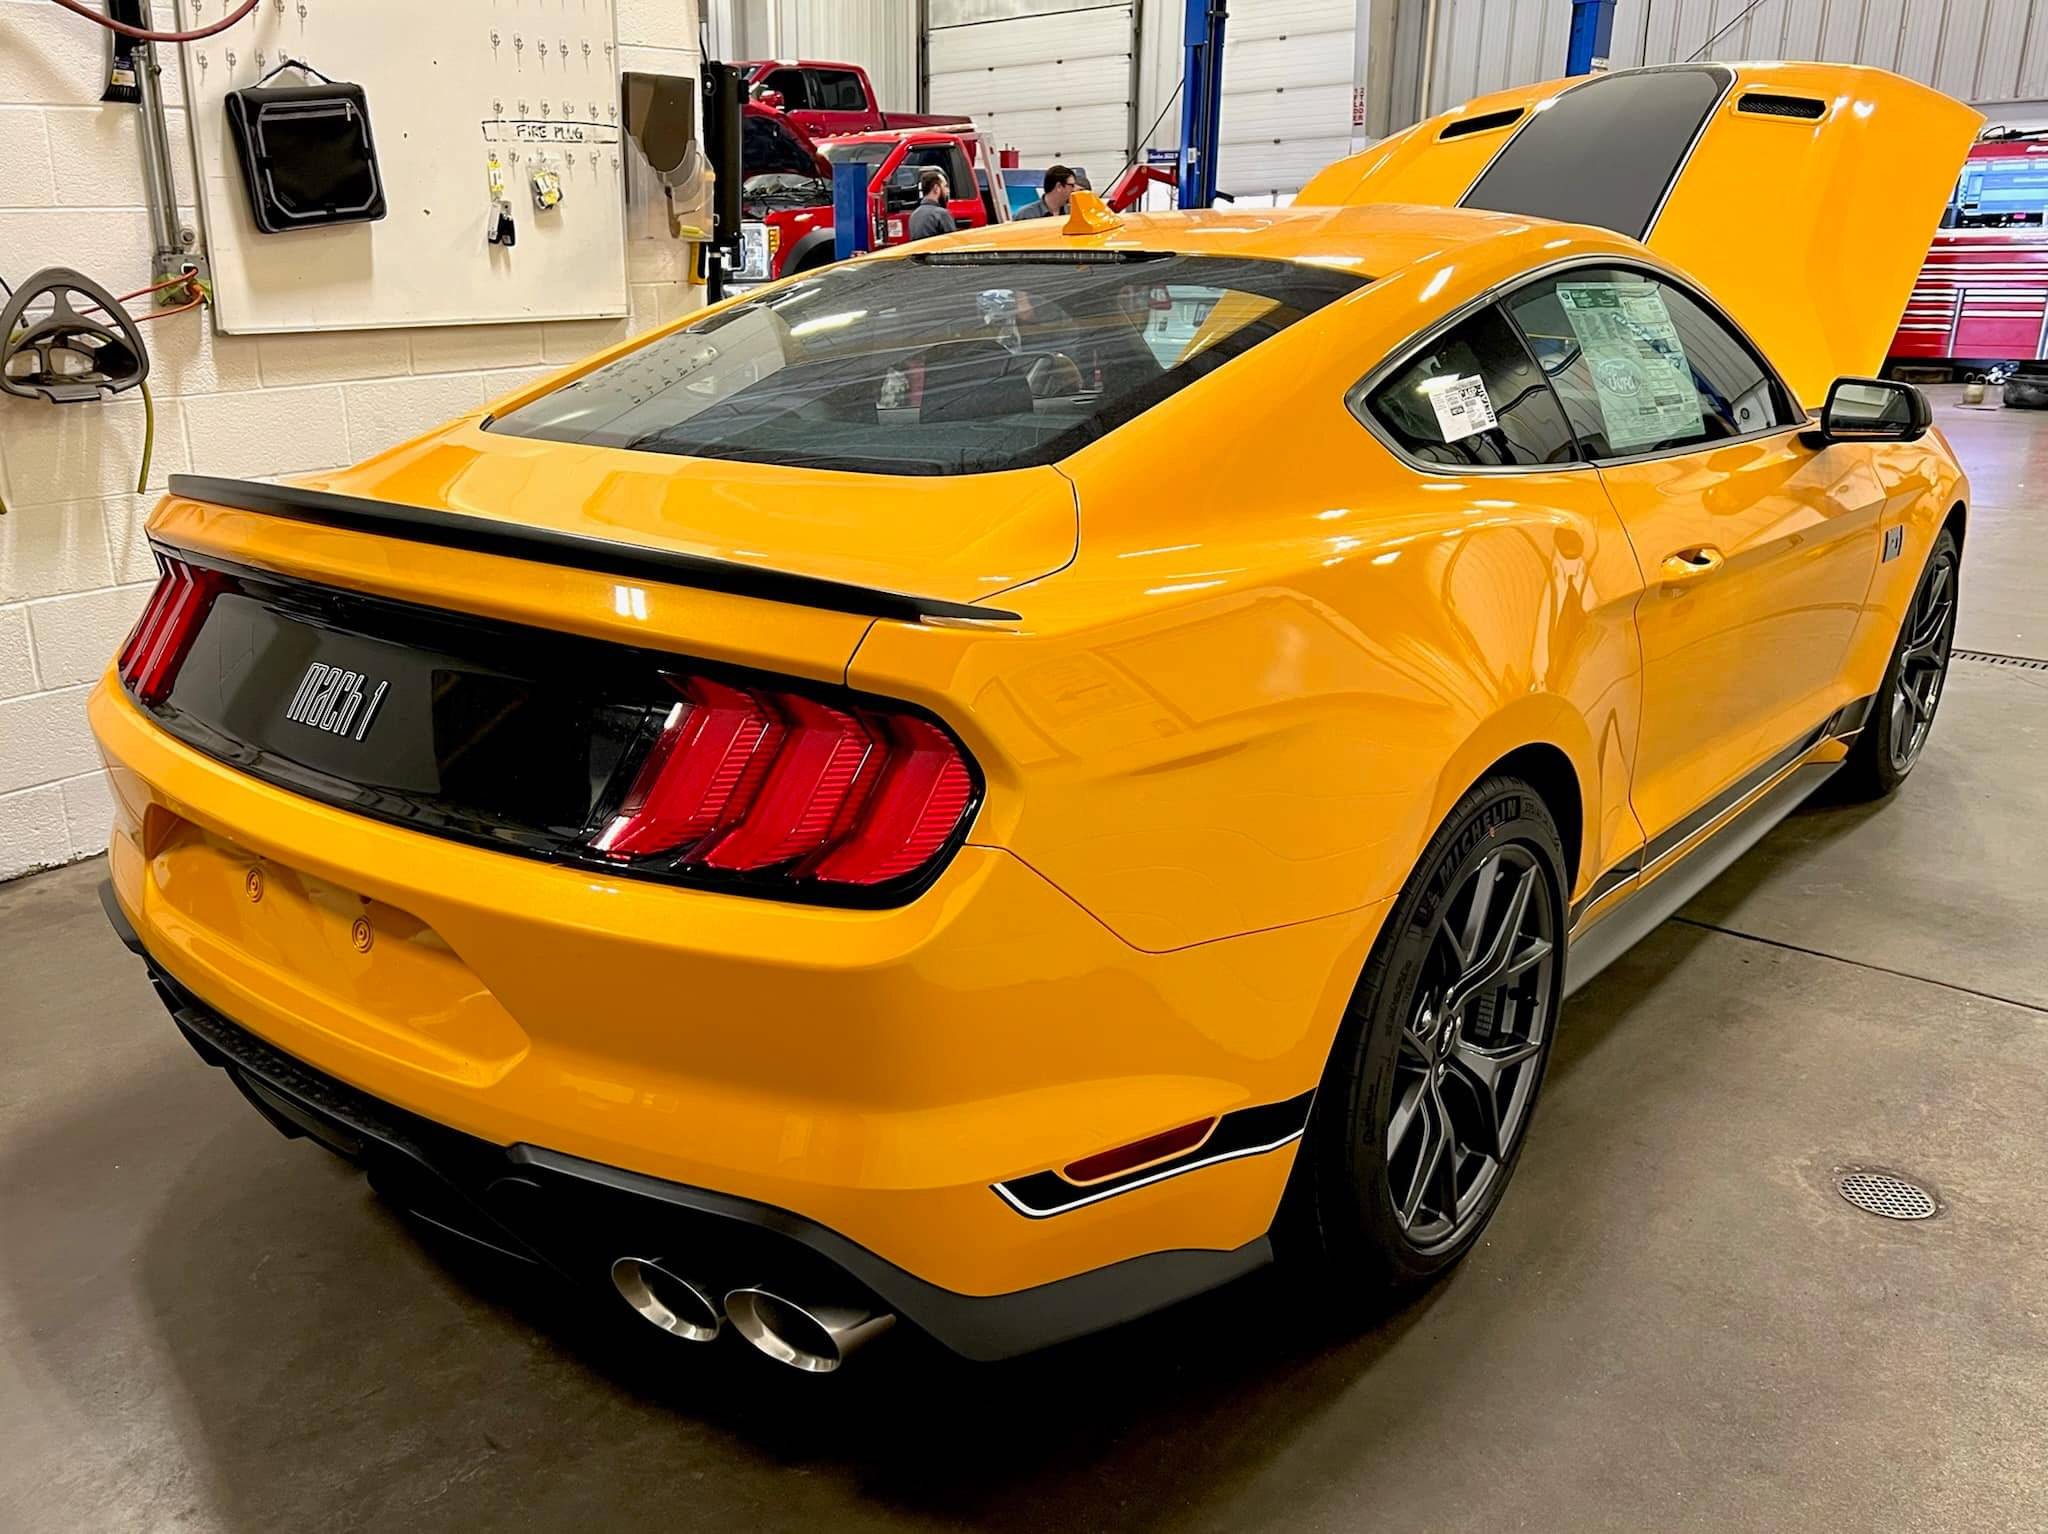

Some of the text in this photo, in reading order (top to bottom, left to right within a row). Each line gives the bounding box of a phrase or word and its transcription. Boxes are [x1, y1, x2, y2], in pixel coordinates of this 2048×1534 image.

[553, 126, 583, 140] PLUG
[355, 680, 388, 741] 1
[1438, 799, 1518, 889] MICHELIN
